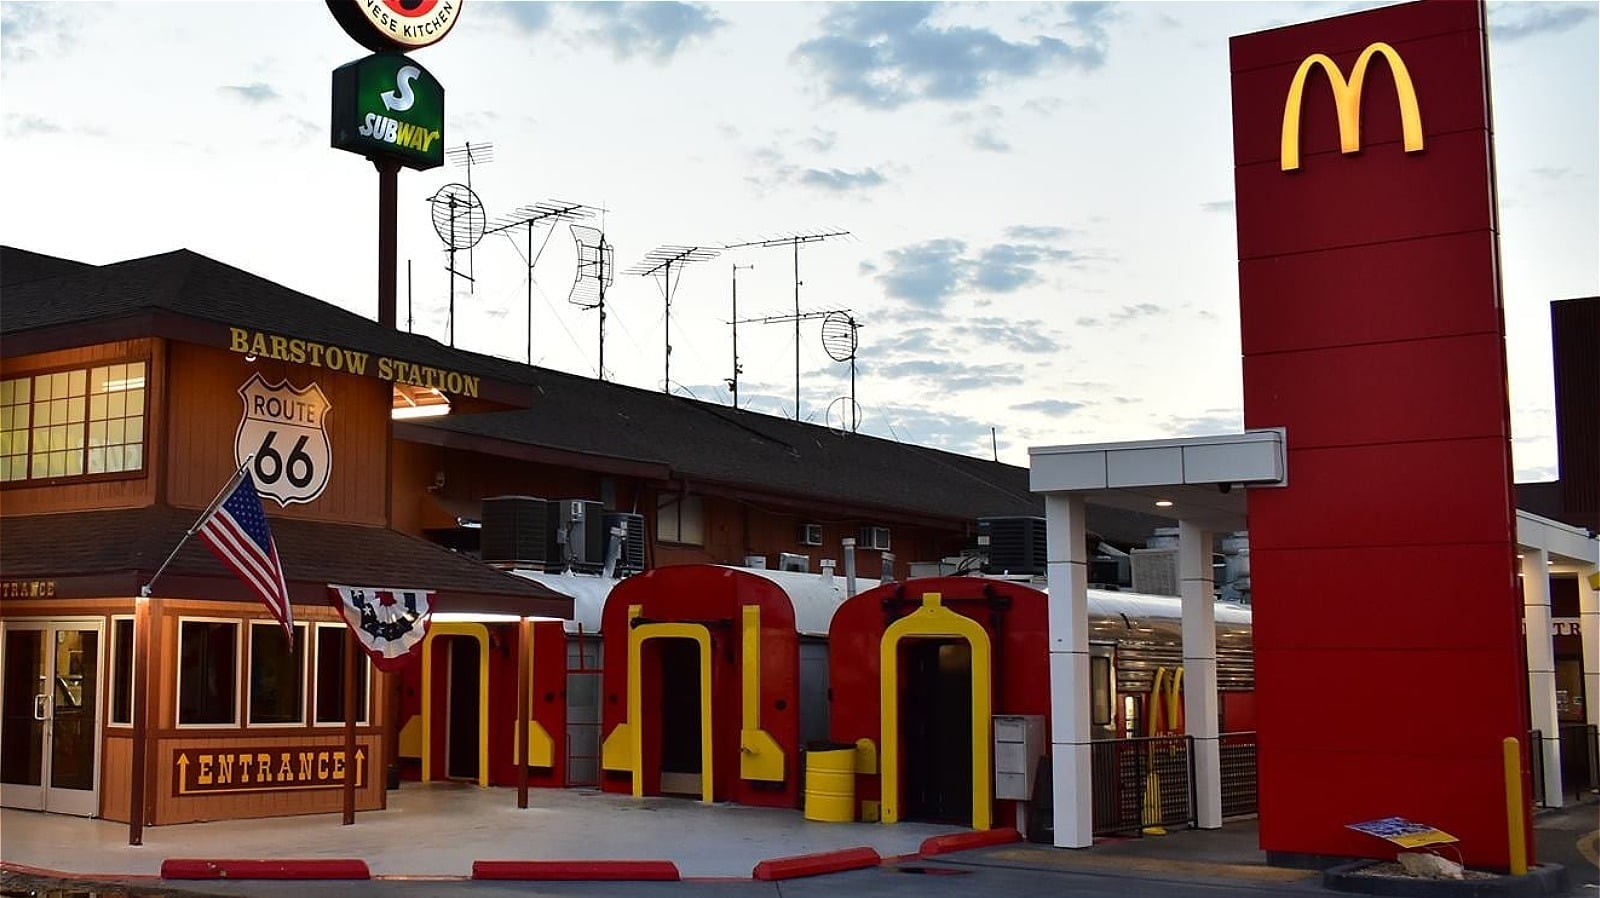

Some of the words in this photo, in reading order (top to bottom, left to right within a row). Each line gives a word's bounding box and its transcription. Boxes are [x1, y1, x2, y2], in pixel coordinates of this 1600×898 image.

[403, 1, 453, 38] KITCHEN
[358, 112, 440, 153] SUBWAY
[229, 327, 370, 376] BARSTOW
[377, 355, 480, 398] STATION
[253, 394, 316, 424] ROUTE
[253, 430, 315, 489] 66
[0, 581, 55, 598] TRANCE
[198, 751, 346, 785] ENTRANCE
